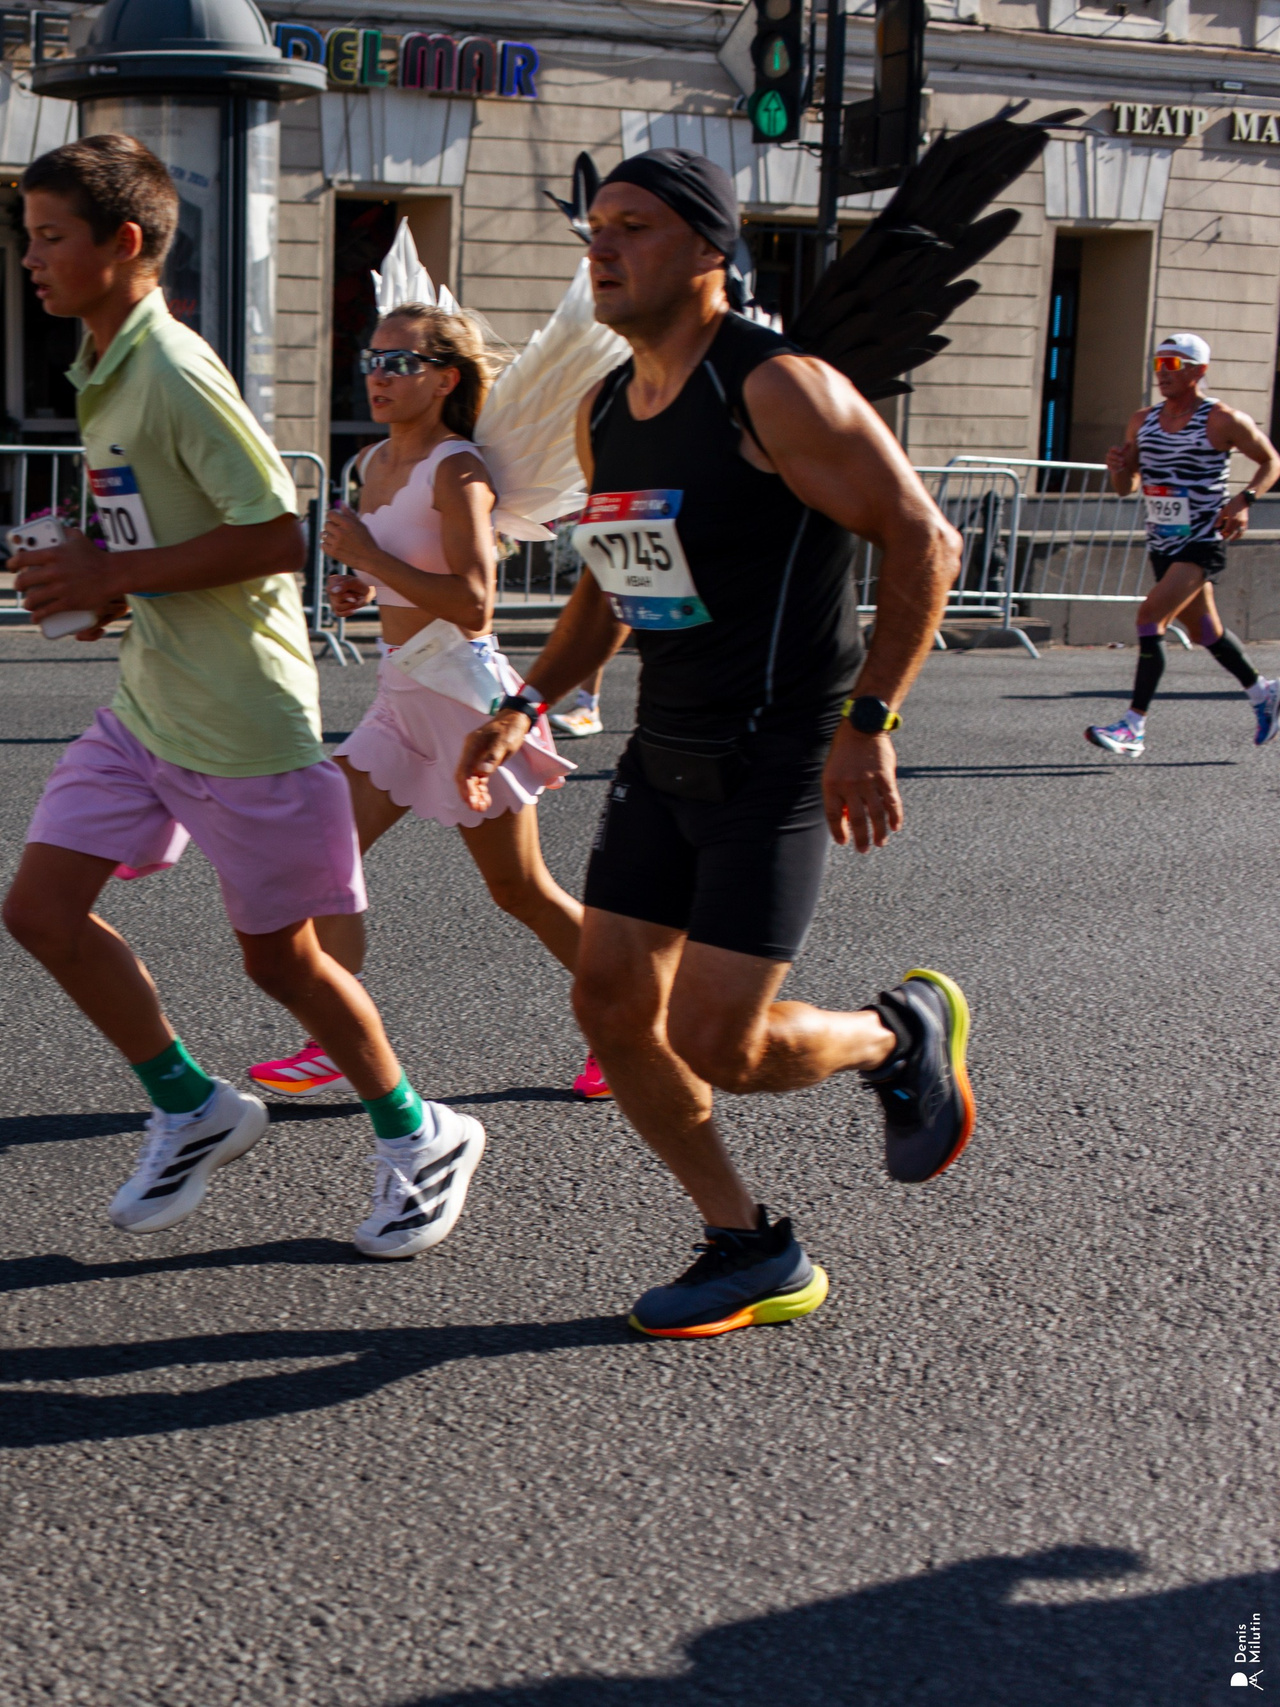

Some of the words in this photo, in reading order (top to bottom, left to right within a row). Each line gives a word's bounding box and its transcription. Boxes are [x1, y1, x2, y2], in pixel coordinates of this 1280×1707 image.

[271, 22, 389, 88] DEL
[398, 31, 539, 99] MAR
[1113, 102, 1209, 137] ТЕАТР
[1232, 110, 1280, 143] МА
[590, 531, 673, 571] 1745
